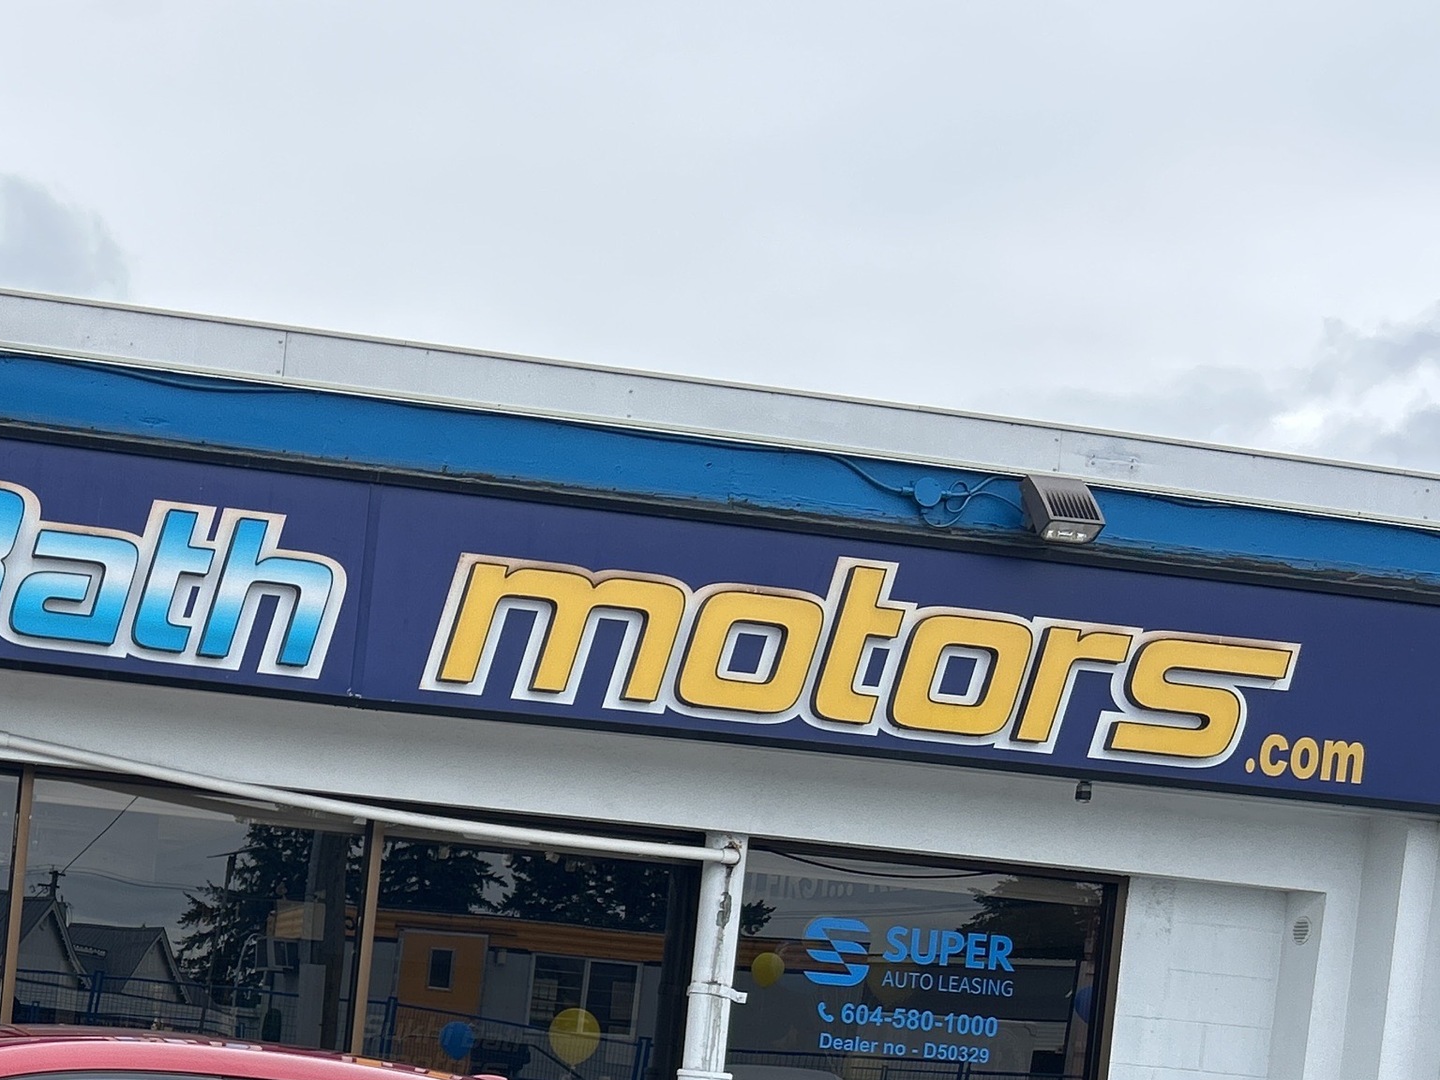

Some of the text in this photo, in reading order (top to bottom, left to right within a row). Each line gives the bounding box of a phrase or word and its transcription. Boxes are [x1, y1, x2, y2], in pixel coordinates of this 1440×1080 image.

[418, 553, 1302, 769] motors
[1244, 731, 1366, 785] .com
[882, 926, 1015, 973] SUPER
[881, 970, 1014, 998] AUTO LEASING
[840, 1002, 999, 1038] 604-580-1000
[818, 1032, 878, 1054] Dealer
[883, 1043, 907, 1057] no
[923, 1042, 990, 1064] D50329
